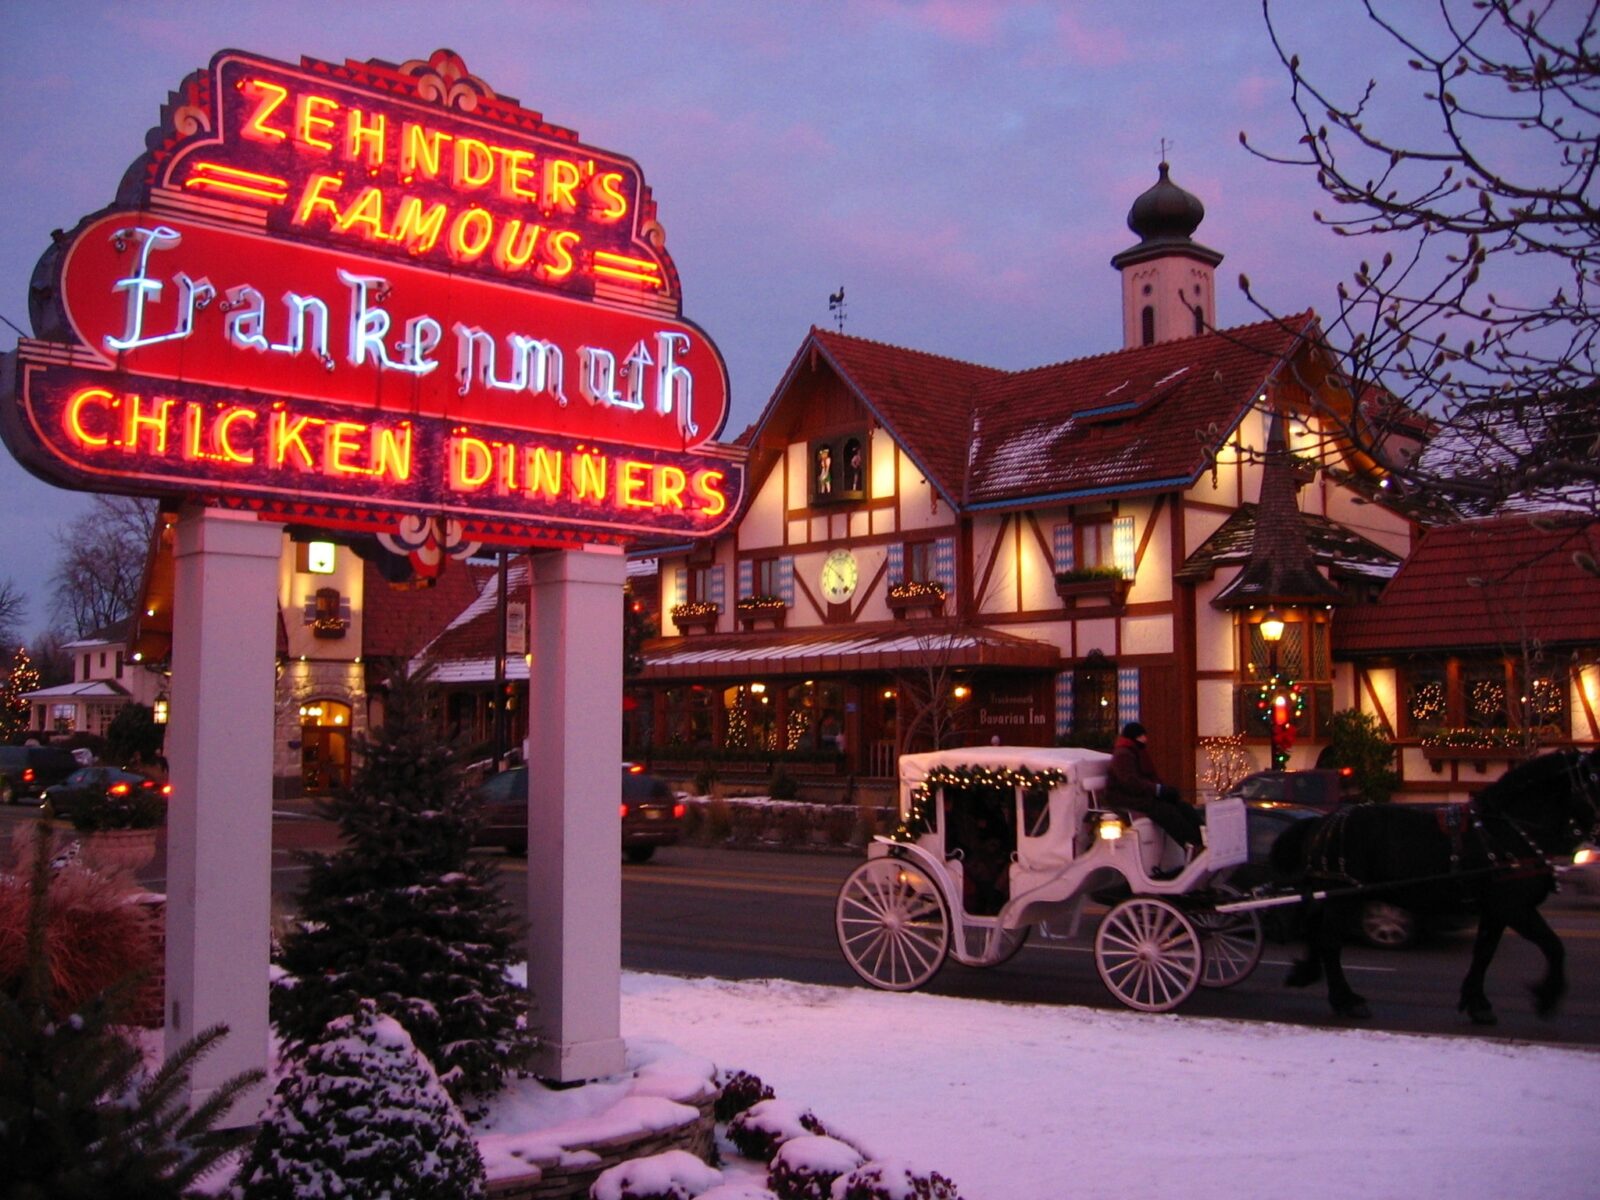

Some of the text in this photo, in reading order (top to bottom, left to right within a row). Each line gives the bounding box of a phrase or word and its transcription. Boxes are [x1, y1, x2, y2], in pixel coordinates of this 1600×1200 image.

[240, 78, 627, 222] ZEHNDER'S
[292, 174, 580, 279] FAMOUS
[103, 226, 698, 441] Frankenmuth
[63, 387, 726, 519] CHICKEN DINNERS
[980, 707, 1046, 724] Bavarian Inn
